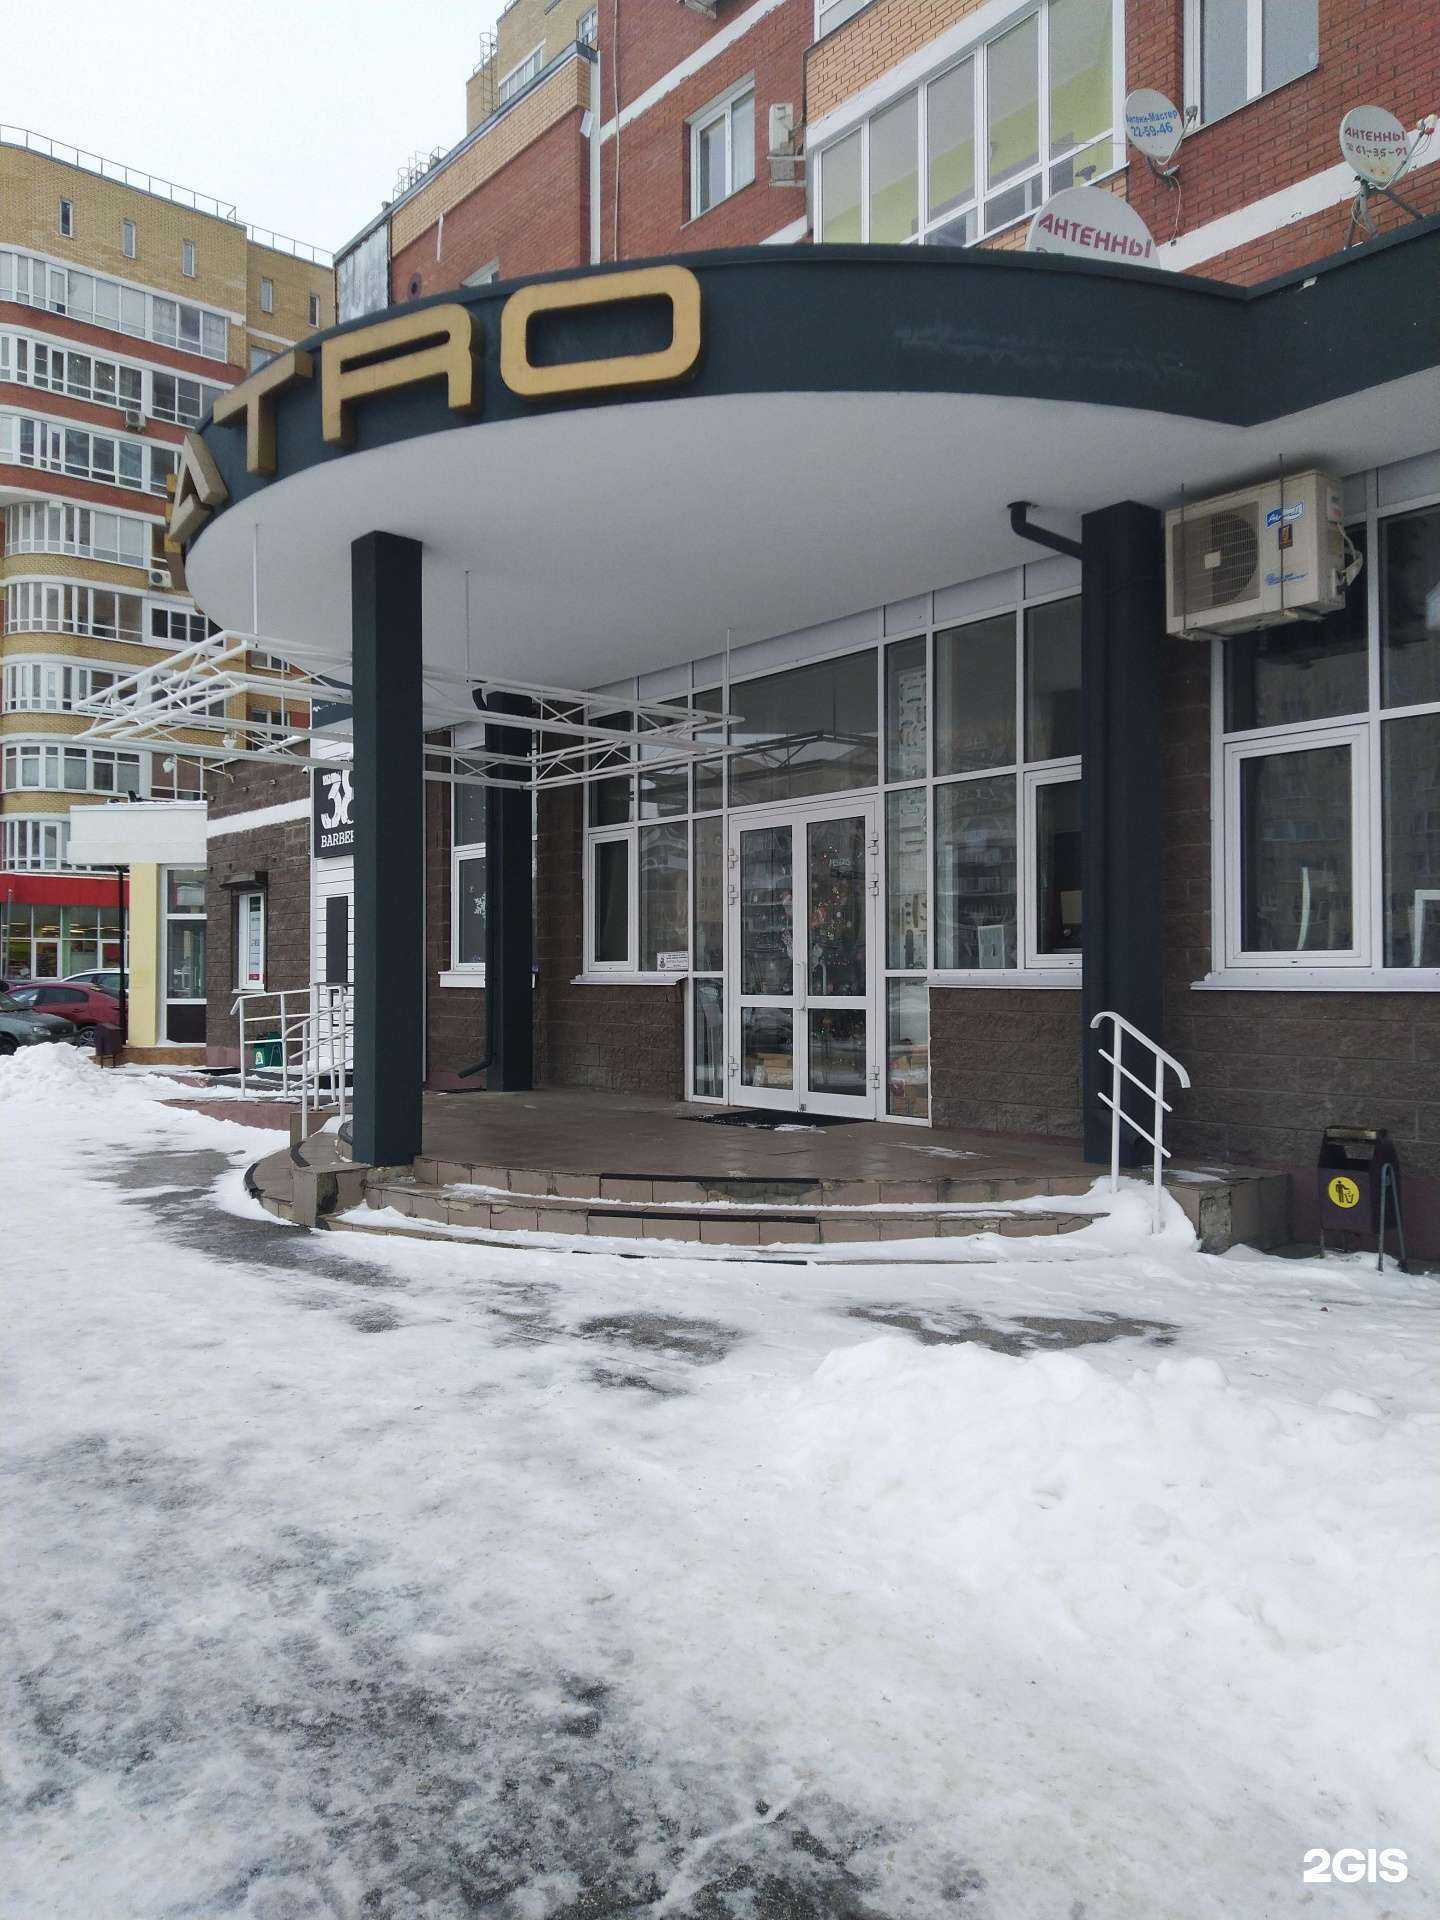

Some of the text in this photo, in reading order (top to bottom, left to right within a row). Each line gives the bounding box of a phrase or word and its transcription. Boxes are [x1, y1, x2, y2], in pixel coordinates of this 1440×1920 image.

[1345, 127, 1405, 142] АНТЕННЫ
[1039, 213, 1152, 258] АНТЕННЫ
[163, 264, 702, 565] ATRO
